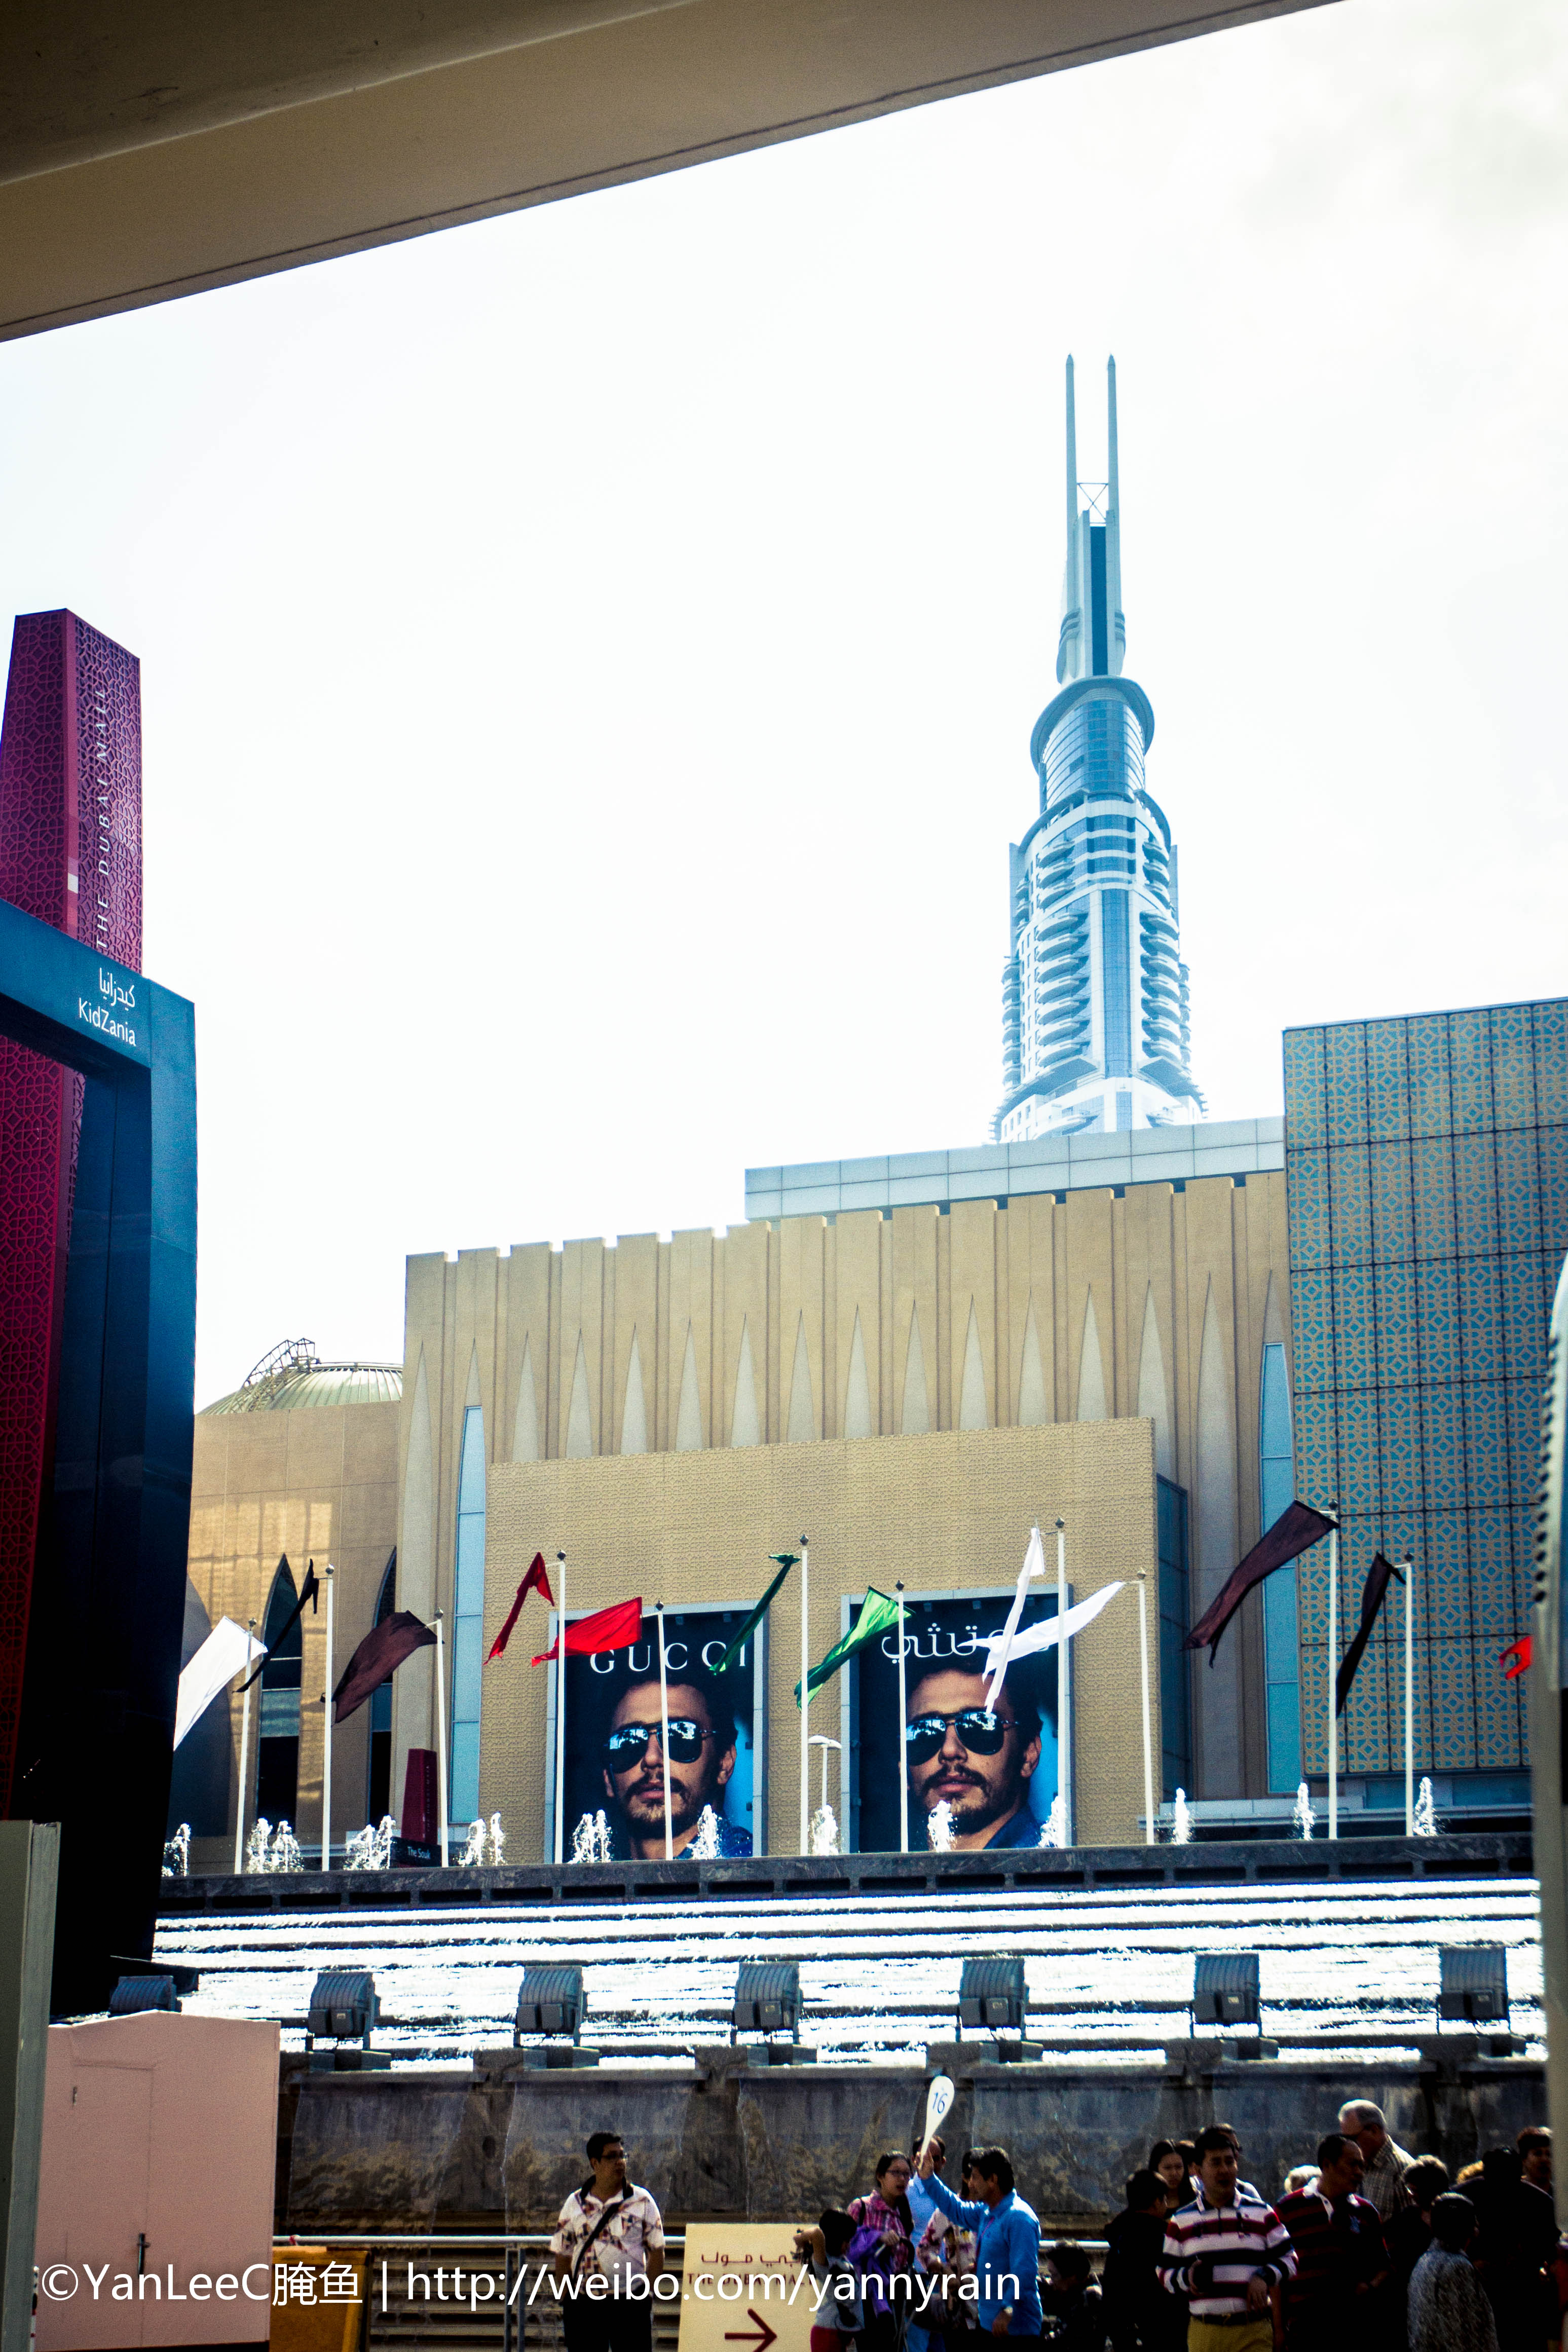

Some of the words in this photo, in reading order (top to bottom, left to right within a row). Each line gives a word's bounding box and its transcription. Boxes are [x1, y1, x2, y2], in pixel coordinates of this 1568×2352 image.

[95, 690, 106, 762] MALL
[97, 778, 110, 876] DUBAI
[96, 894, 108, 948] THE
[99, 967, 136, 1011] كيدزانيا
[79, 997, 136, 1047] KidZania
[590, 1641, 745, 1673] GUCCI
[932, 2092, 948, 2114] 16
